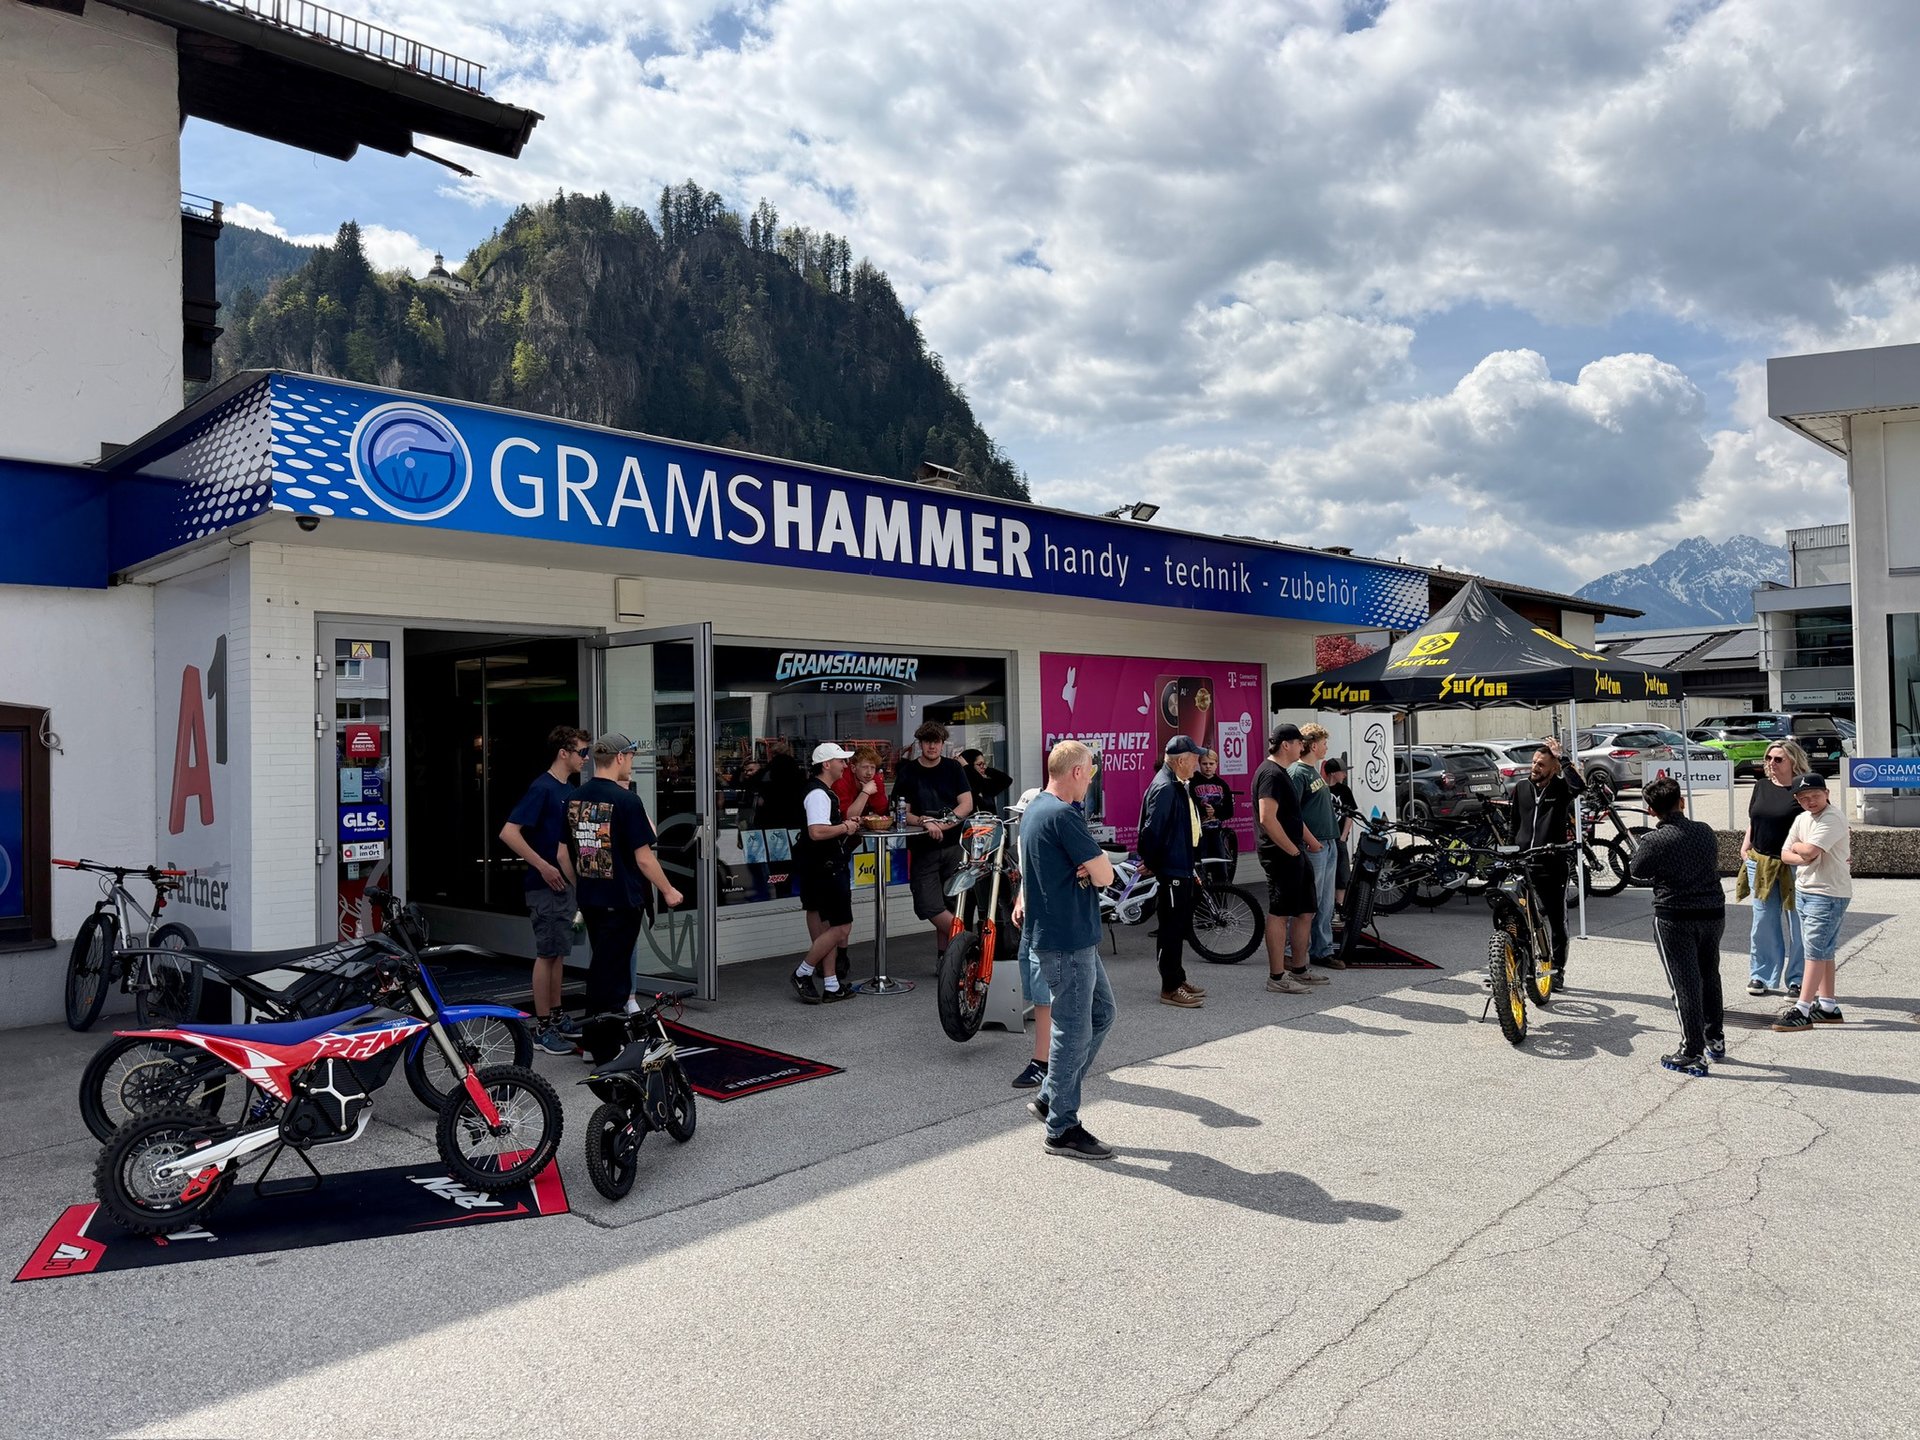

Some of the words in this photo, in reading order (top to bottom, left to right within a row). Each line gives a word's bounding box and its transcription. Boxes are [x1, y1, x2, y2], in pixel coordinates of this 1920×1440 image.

[490, 437, 1033, 578] GRAMSHAMMER
[1044, 534, 1129, 587] handy
[1165, 555, 1251, 593] technik
[1279, 571, 1358, 606] zubehör
[776, 652, 919, 682] GRAMSHAMMER
[820, 681, 881, 692] E-POWER
[1310, 680, 1370, 705] Surron
[1439, 673, 1508, 700] Surron
[169, 634, 228, 834] A1
[1118, 733, 1150, 750] NETZ
[167, 862, 229, 911] Partner
[770, 1067, 801, 1078] PRO
